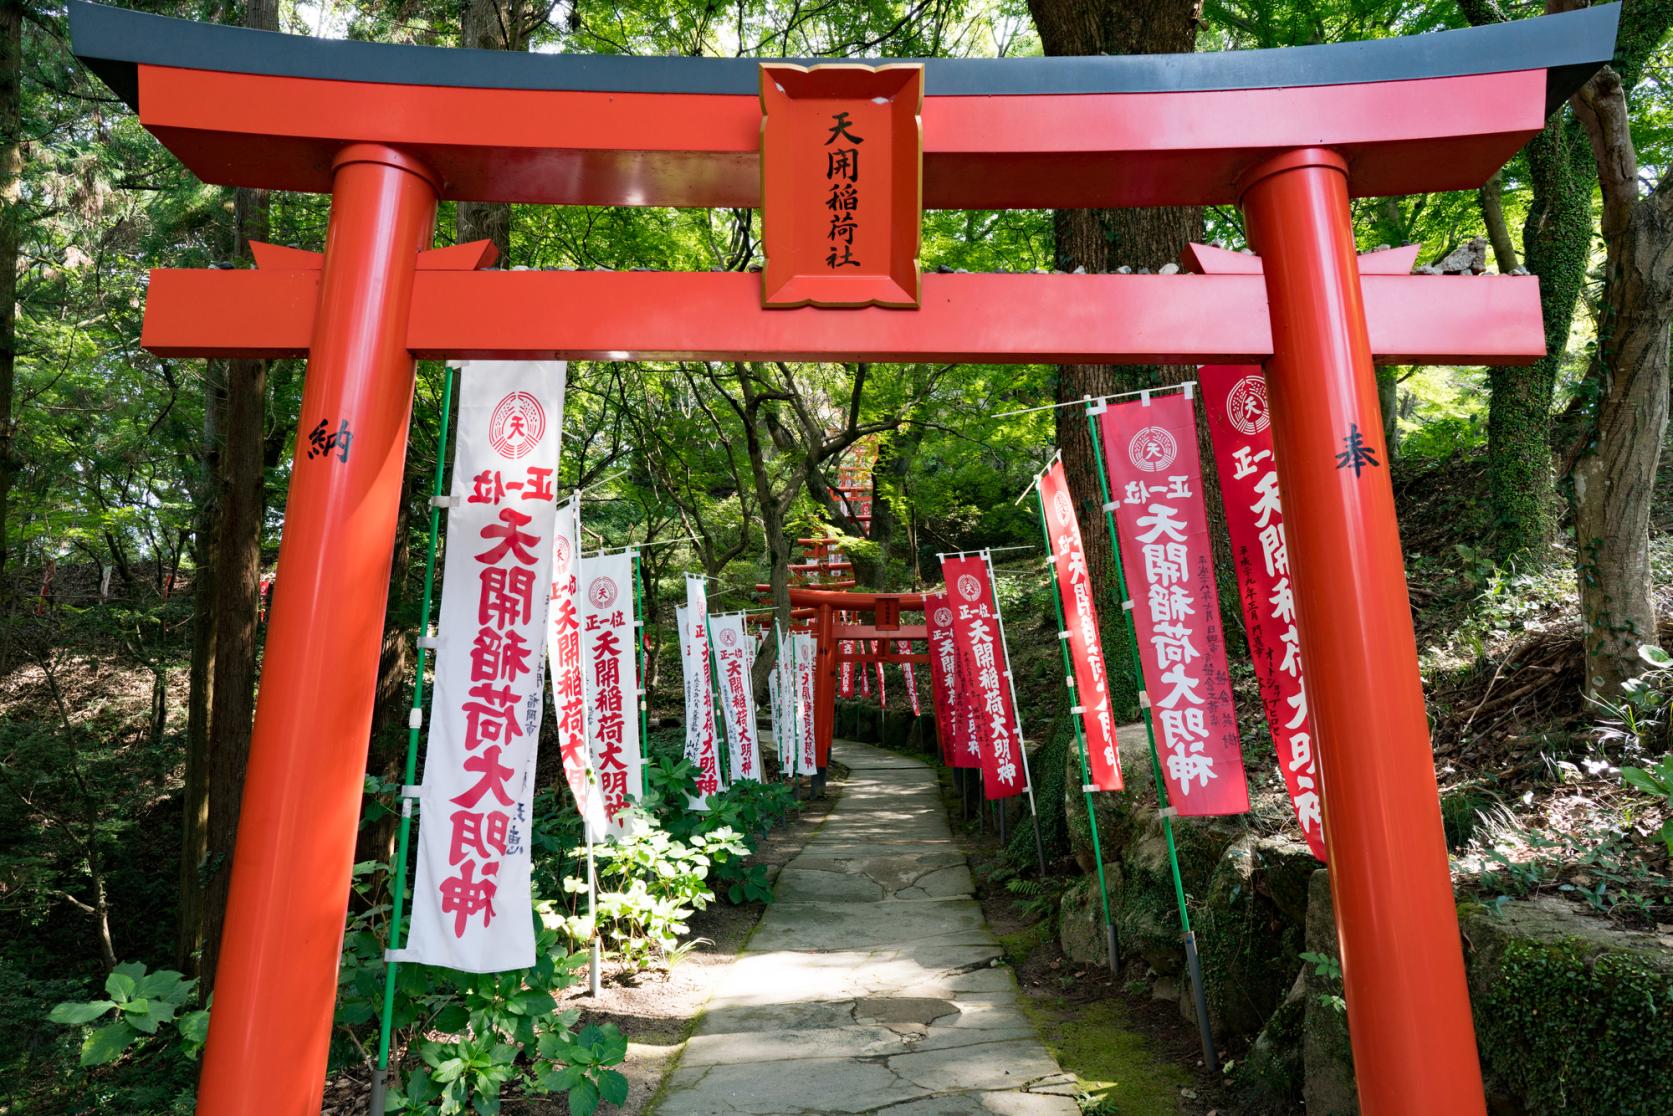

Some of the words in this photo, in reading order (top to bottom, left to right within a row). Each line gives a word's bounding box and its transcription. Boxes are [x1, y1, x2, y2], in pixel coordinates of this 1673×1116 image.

[824, 112, 864, 269] 天開稲荷社
[307, 418, 353, 463] 納
[1232, 446, 1276, 480] 正一
[1335, 423, 1380, 479] 奉
[585, 610, 626, 631] 正一位
[959, 603, 990, 620] 正一位
[968, 619, 1017, 787] 天開稲荷大明神
[592, 630, 631, 829] 天開稲荷大明神
